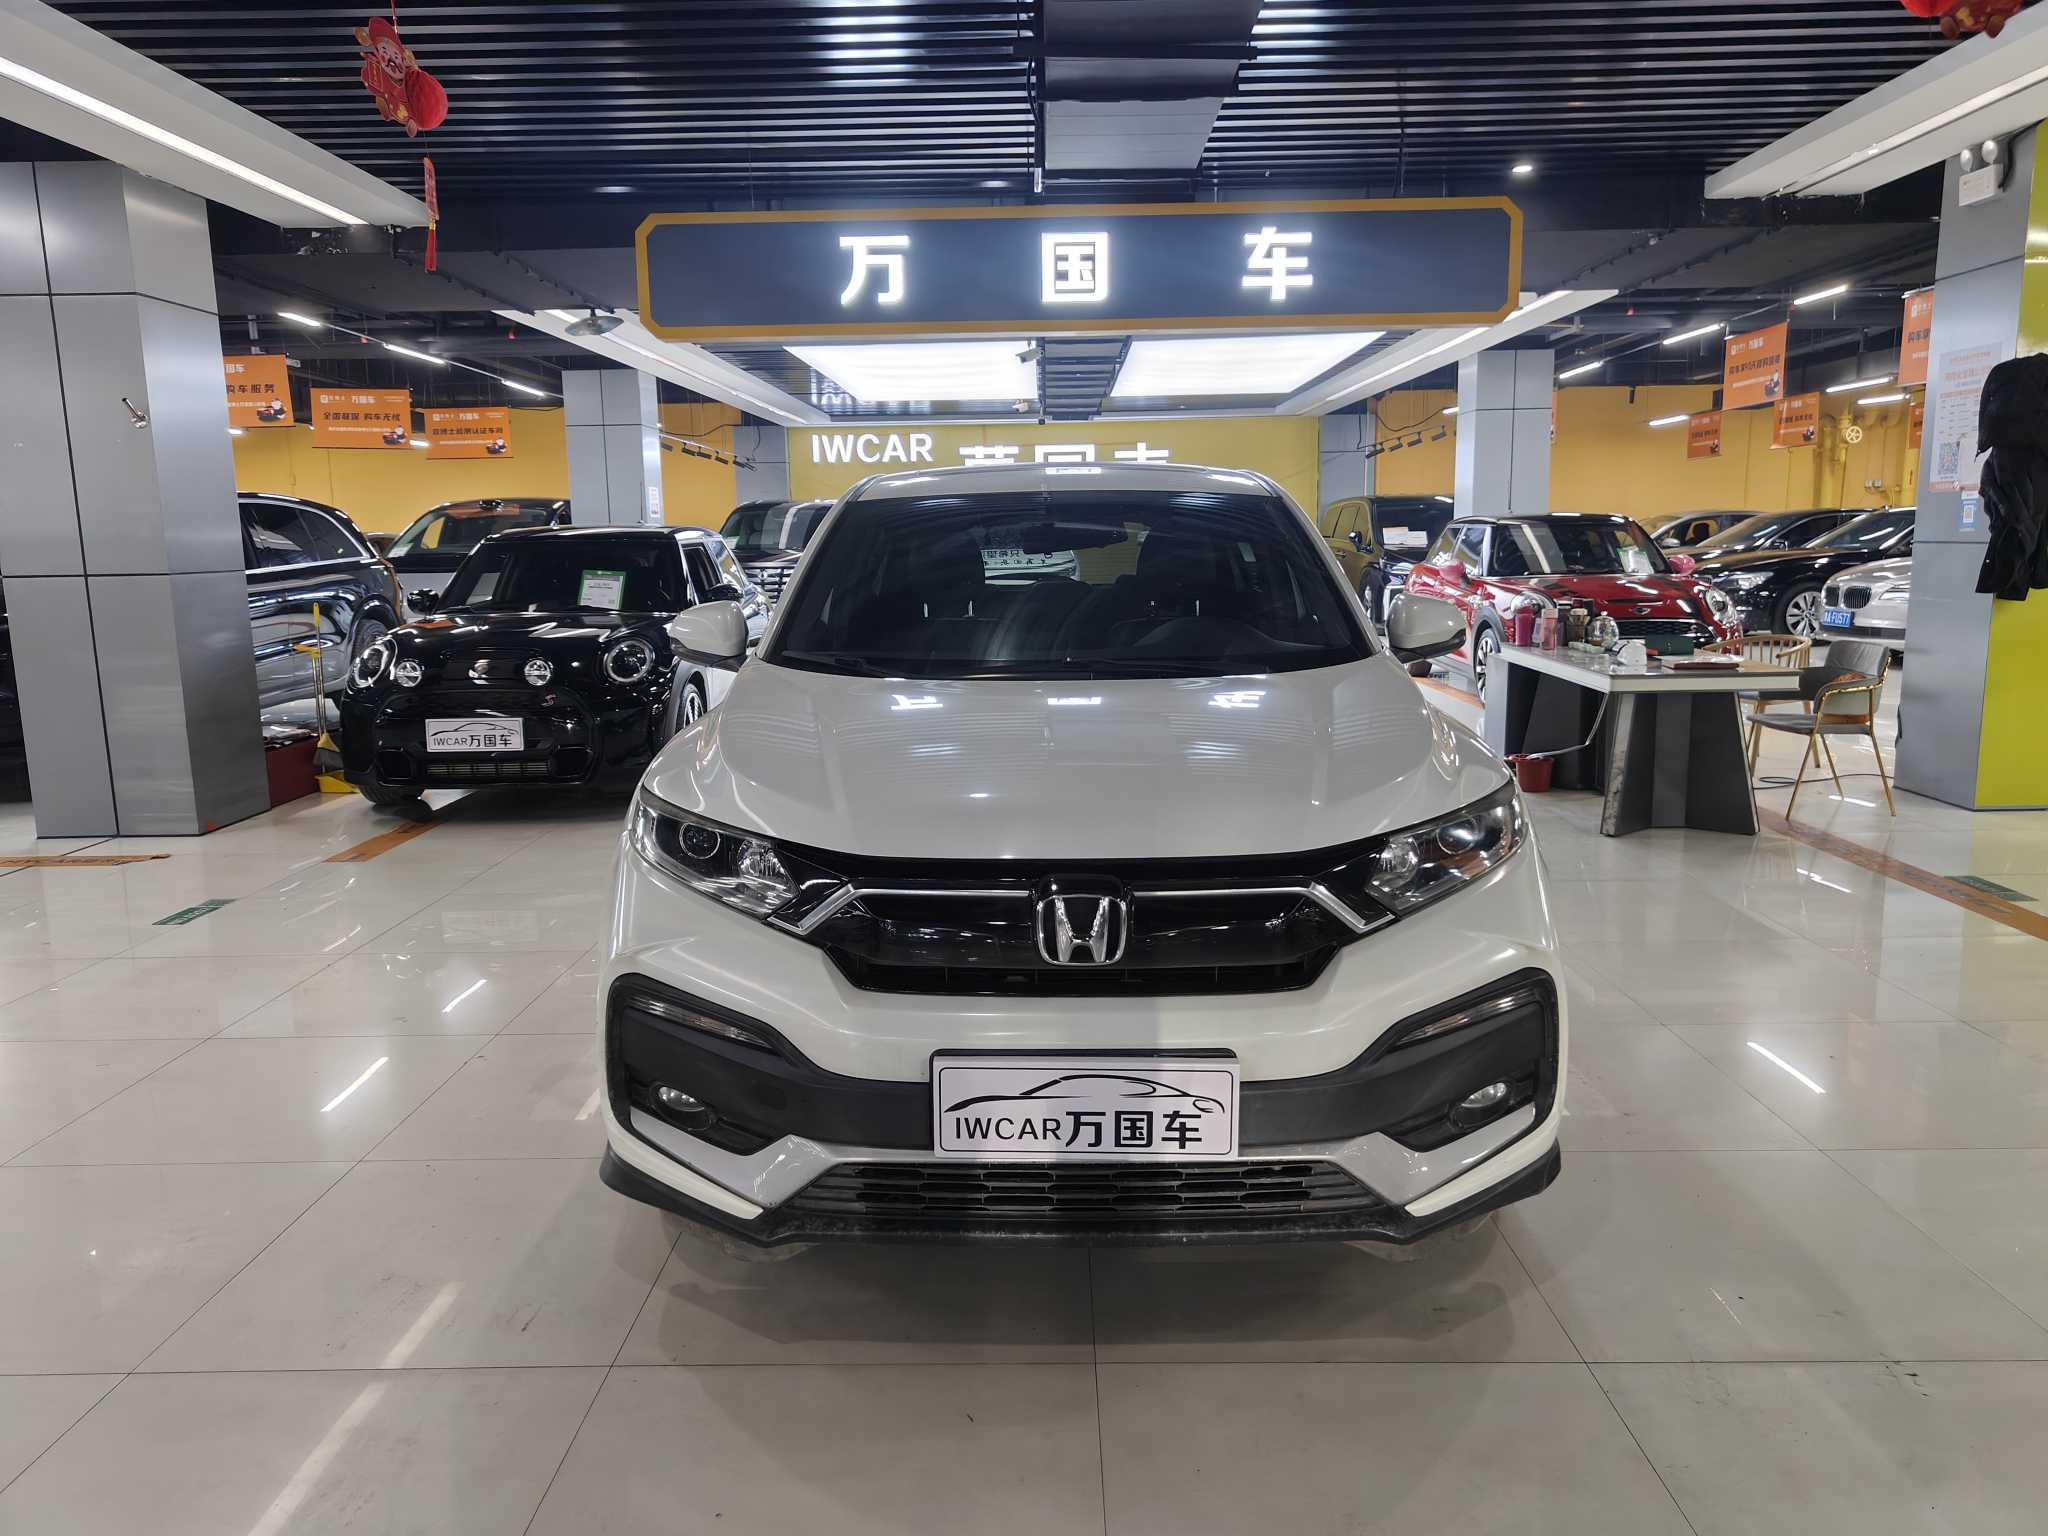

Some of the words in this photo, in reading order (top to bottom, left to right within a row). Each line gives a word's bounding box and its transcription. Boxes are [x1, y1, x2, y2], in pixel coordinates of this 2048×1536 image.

[839, 226, 1314, 305] 万国车
[811, 432, 934, 464] IWCAR
[433, 734, 513, 747] IWCAR万国车
[954, 1111, 1203, 1150] IWCAR万国车
